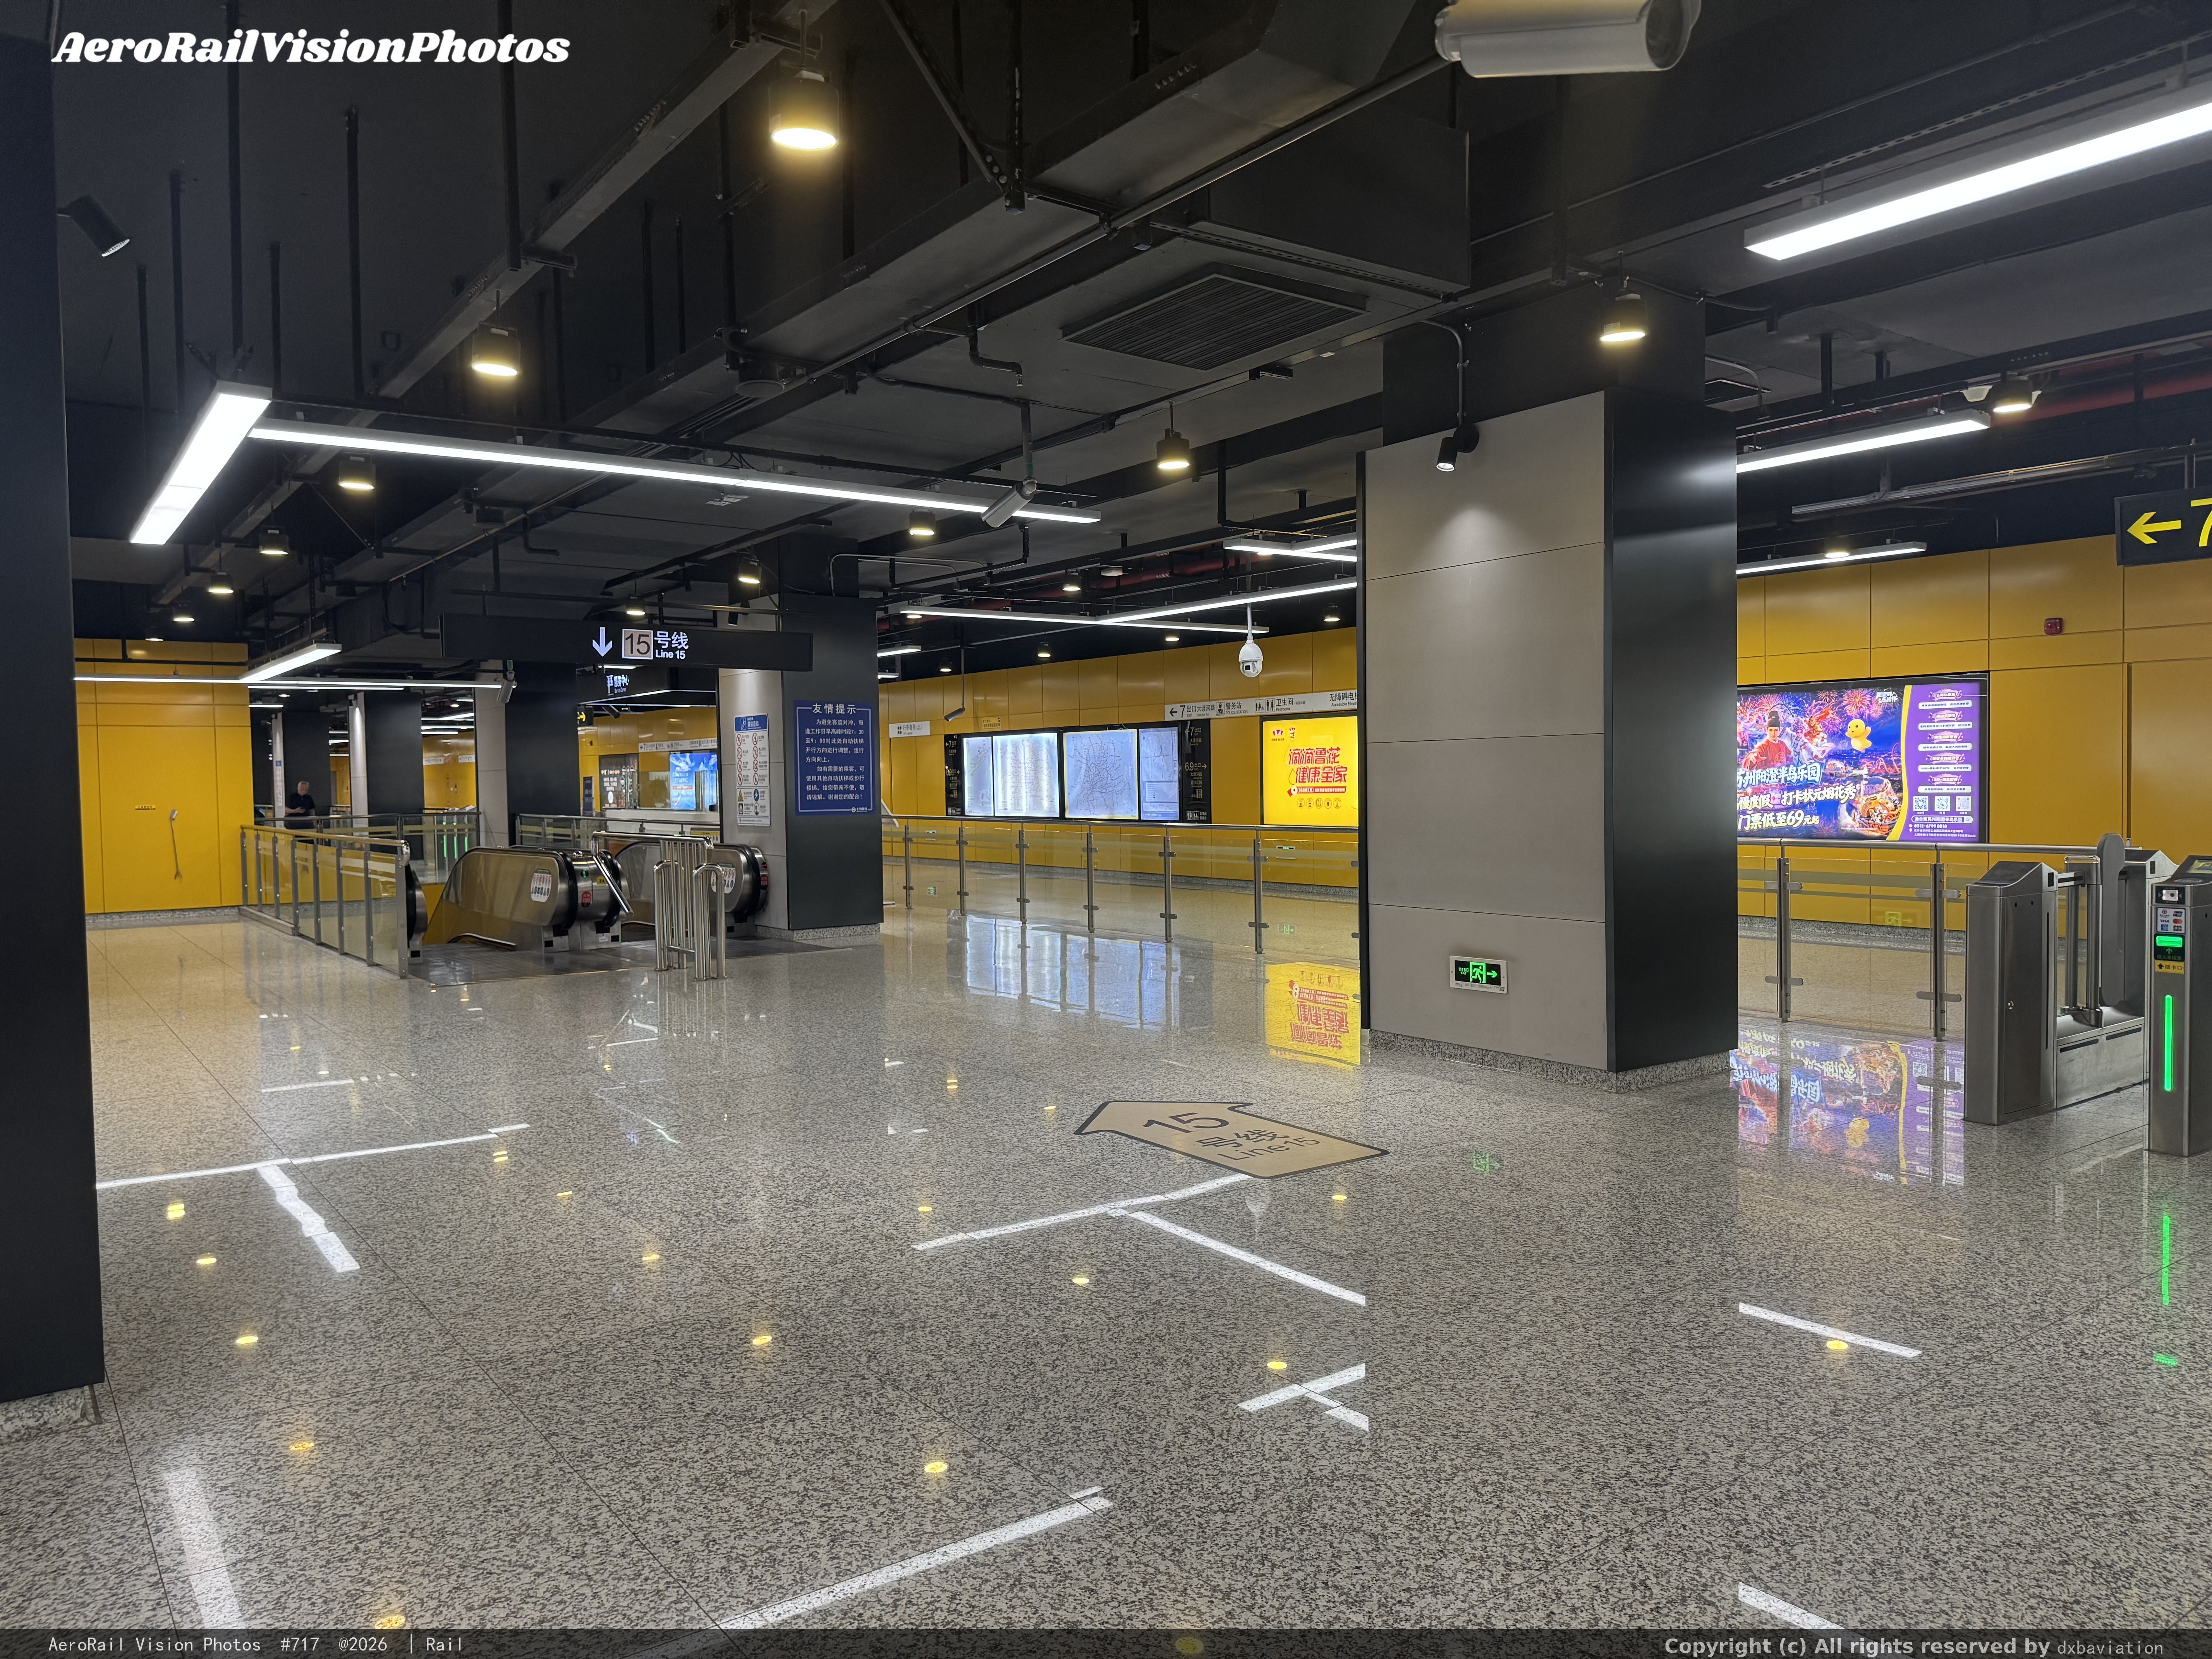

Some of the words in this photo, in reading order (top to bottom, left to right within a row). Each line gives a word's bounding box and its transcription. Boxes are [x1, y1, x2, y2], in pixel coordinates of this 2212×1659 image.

[2191, 498, 2212, 547] 7
[625, 633, 651, 655] 15
[654, 631, 689, 650] 号线
[655, 649, 673, 658] Line
[675, 651, 685, 659] 15
[812, 703, 857, 714] 友情提示
[1226, 702, 1242, 710] 警务站
[1276, 697, 1293, 706] 卫生间
[1180, 705, 1186, 718] 7
[1197, 704, 1215, 712] 大渡河路
[1189, 727, 1194, 736] 7
[1288, 747, 1341, 765] 滴滴鲁花
[1296, 766, 1348, 783] 健康全家
[1737, 762, 1821, 788] 苏州阳澄半岛乐园
[1781, 783, 1857, 806] 打卡状元烟花秀
[1738, 810, 1820, 831] 门票低至69元起
[1143, 1112, 1229, 1133] 15
[1196, 1129, 1290, 1147] 号线
